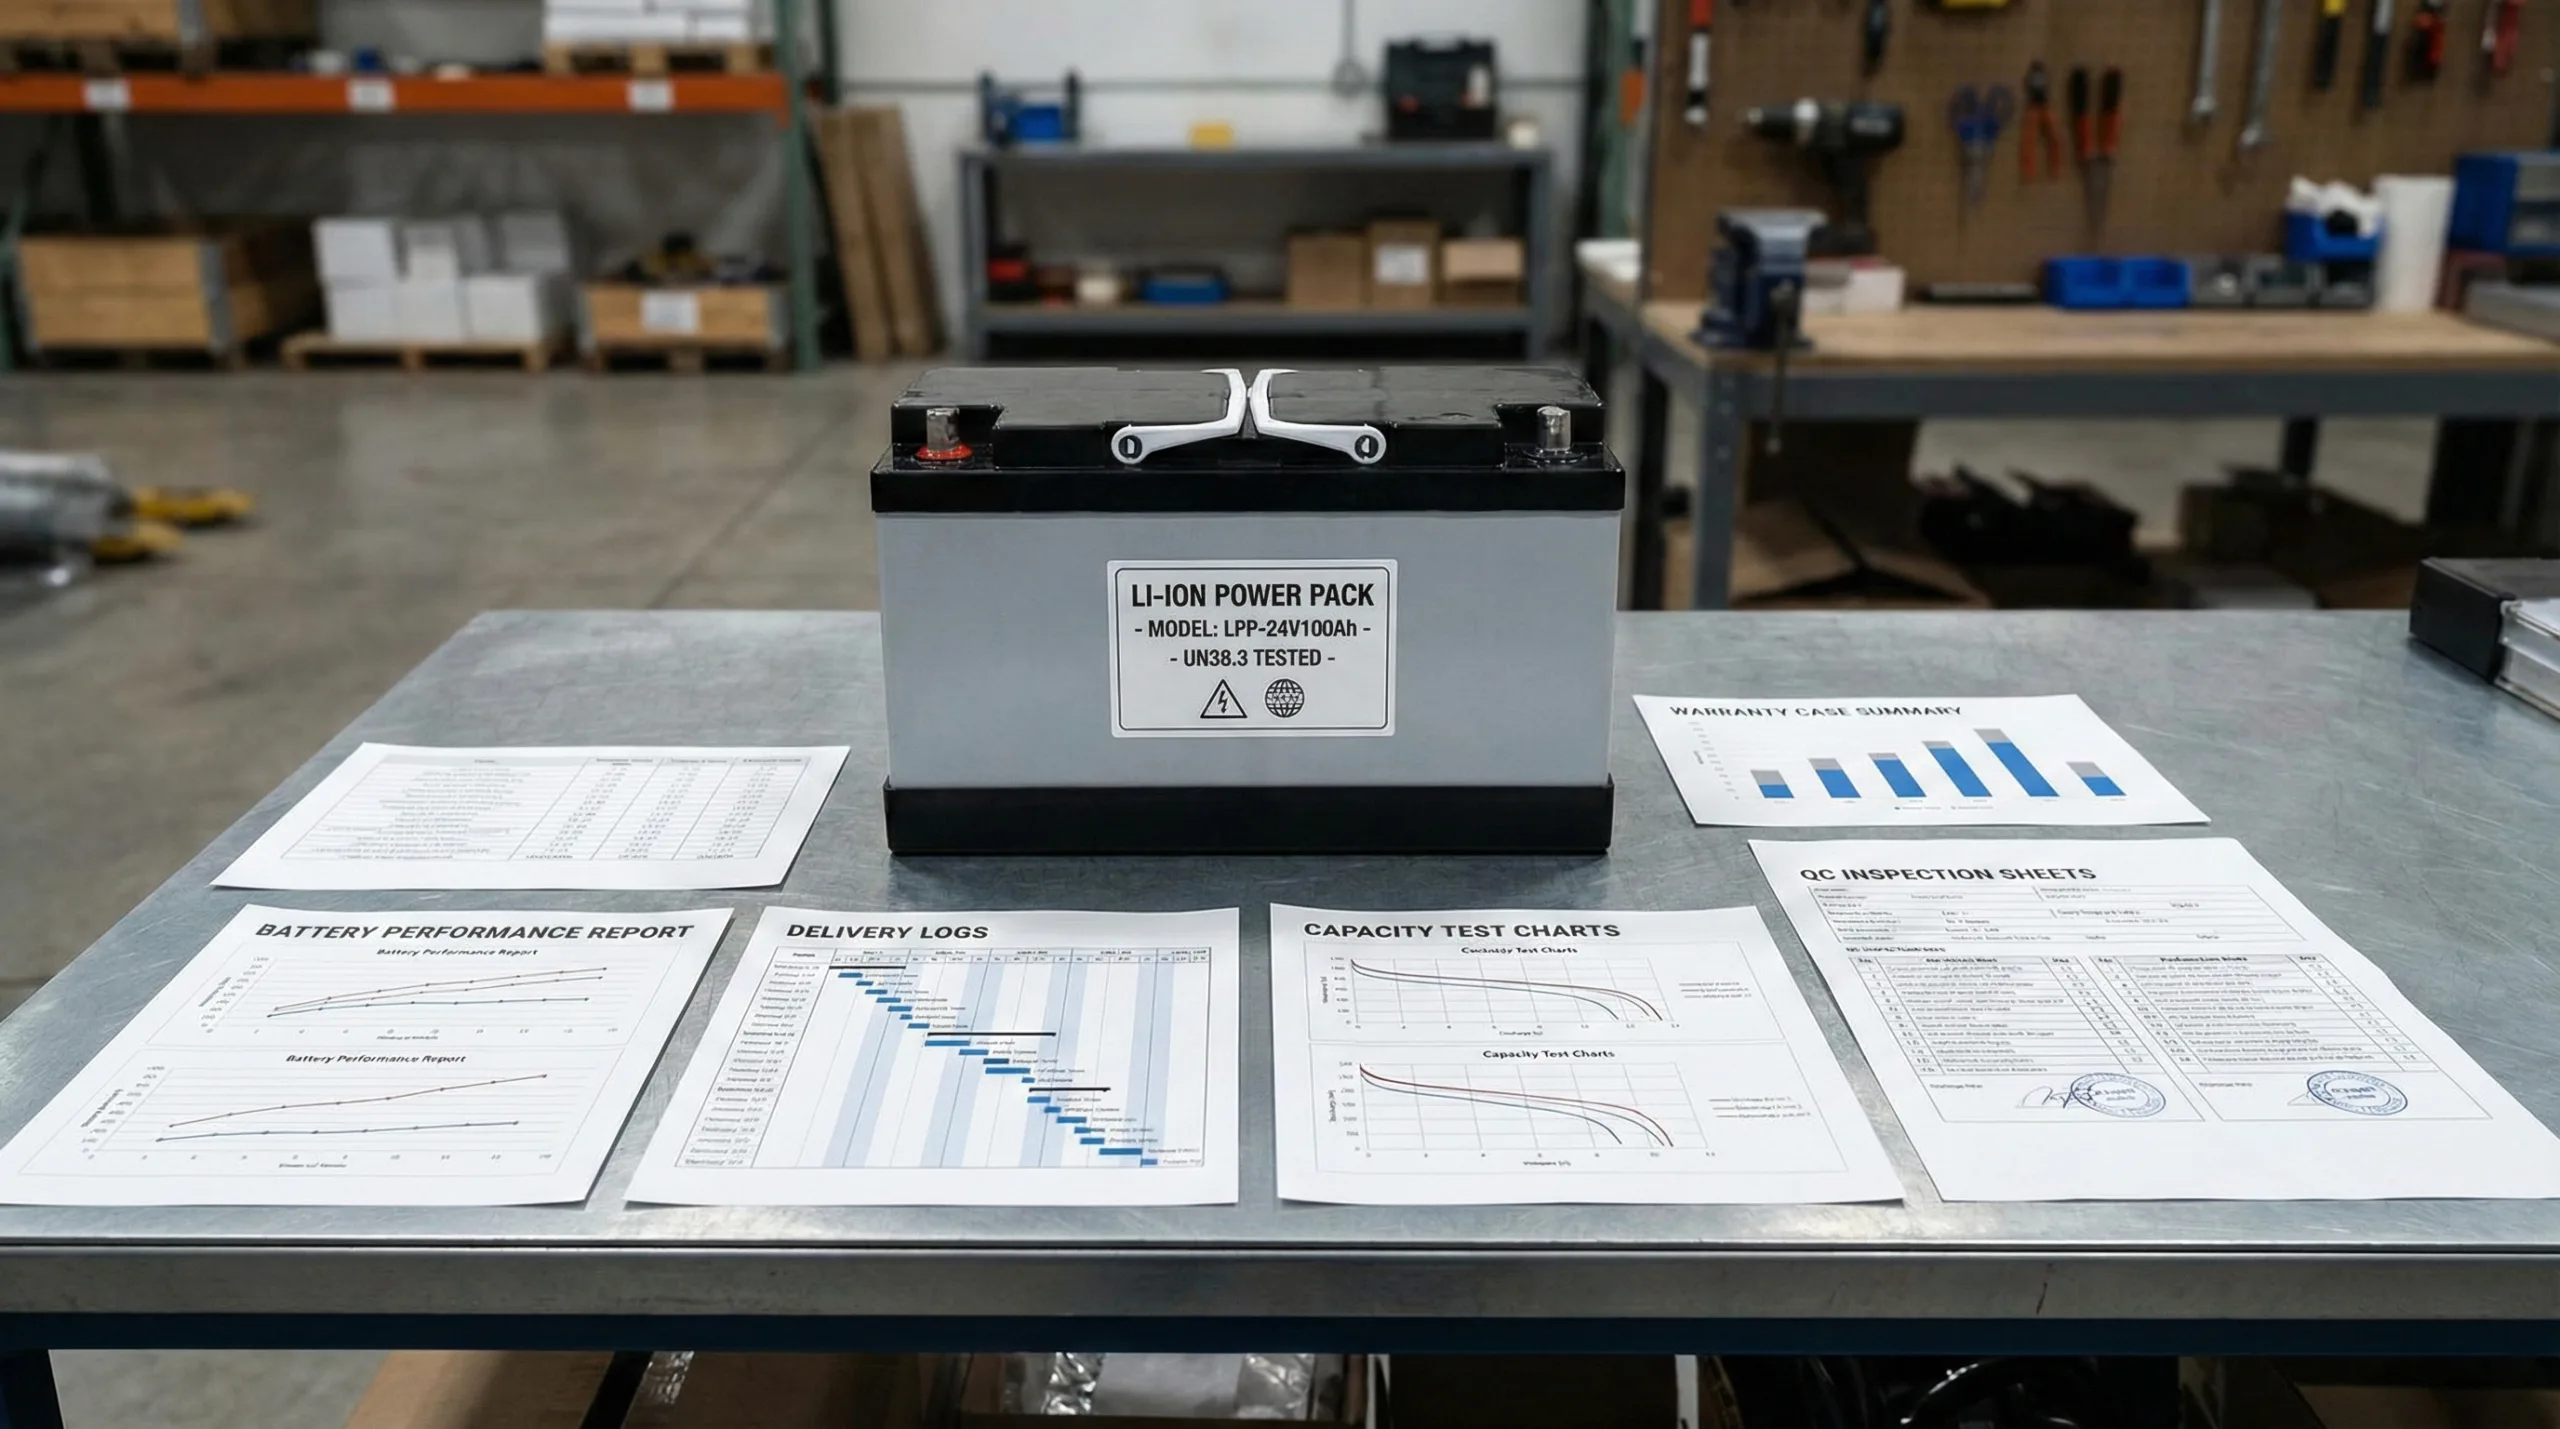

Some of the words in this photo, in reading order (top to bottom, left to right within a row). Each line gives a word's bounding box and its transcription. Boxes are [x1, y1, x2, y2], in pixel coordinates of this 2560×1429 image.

[1131, 583, 1206, 608] LI-ION
[1215, 583, 1302, 608] POWER
[1310, 582, 1375, 607] PACK
[1148, 619, 1218, 638] MODEL:
[1223, 618, 1358, 638] LPP-24V100Ah
[1183, 648, 1249, 668] UN38.3
[1252, 648, 1322, 667] TESTED
[1669, 706, 1787, 717] WARRANTY
[1794, 706, 1853, 717] CASE
[1857, 706, 1961, 716] SUMMARY
[1800, 868, 1836, 882] QC
[1841, 868, 1995, 881] INSPECTION
[1998, 868, 2097, 880] SHEETS
[255, 923, 379, 939] BATTERY
[381, 925, 584, 939] PERFORMANCE
[586, 924, 695, 939] REPORT
[786, 924, 914, 939] DELIVERY
[919, 925, 989, 940] LOGS
[1303, 923, 1434, 939] CAPACITY
[1439, 924, 1506, 938] TEST
[1513, 924, 1621, 938] CHARTS
[285, 1054, 336, 1064] Battery
[1482, 1050, 1539, 1060] Capacity
[1540, 1049, 1570, 1058] Test
[1572, 1049, 1615, 1058] Charts
